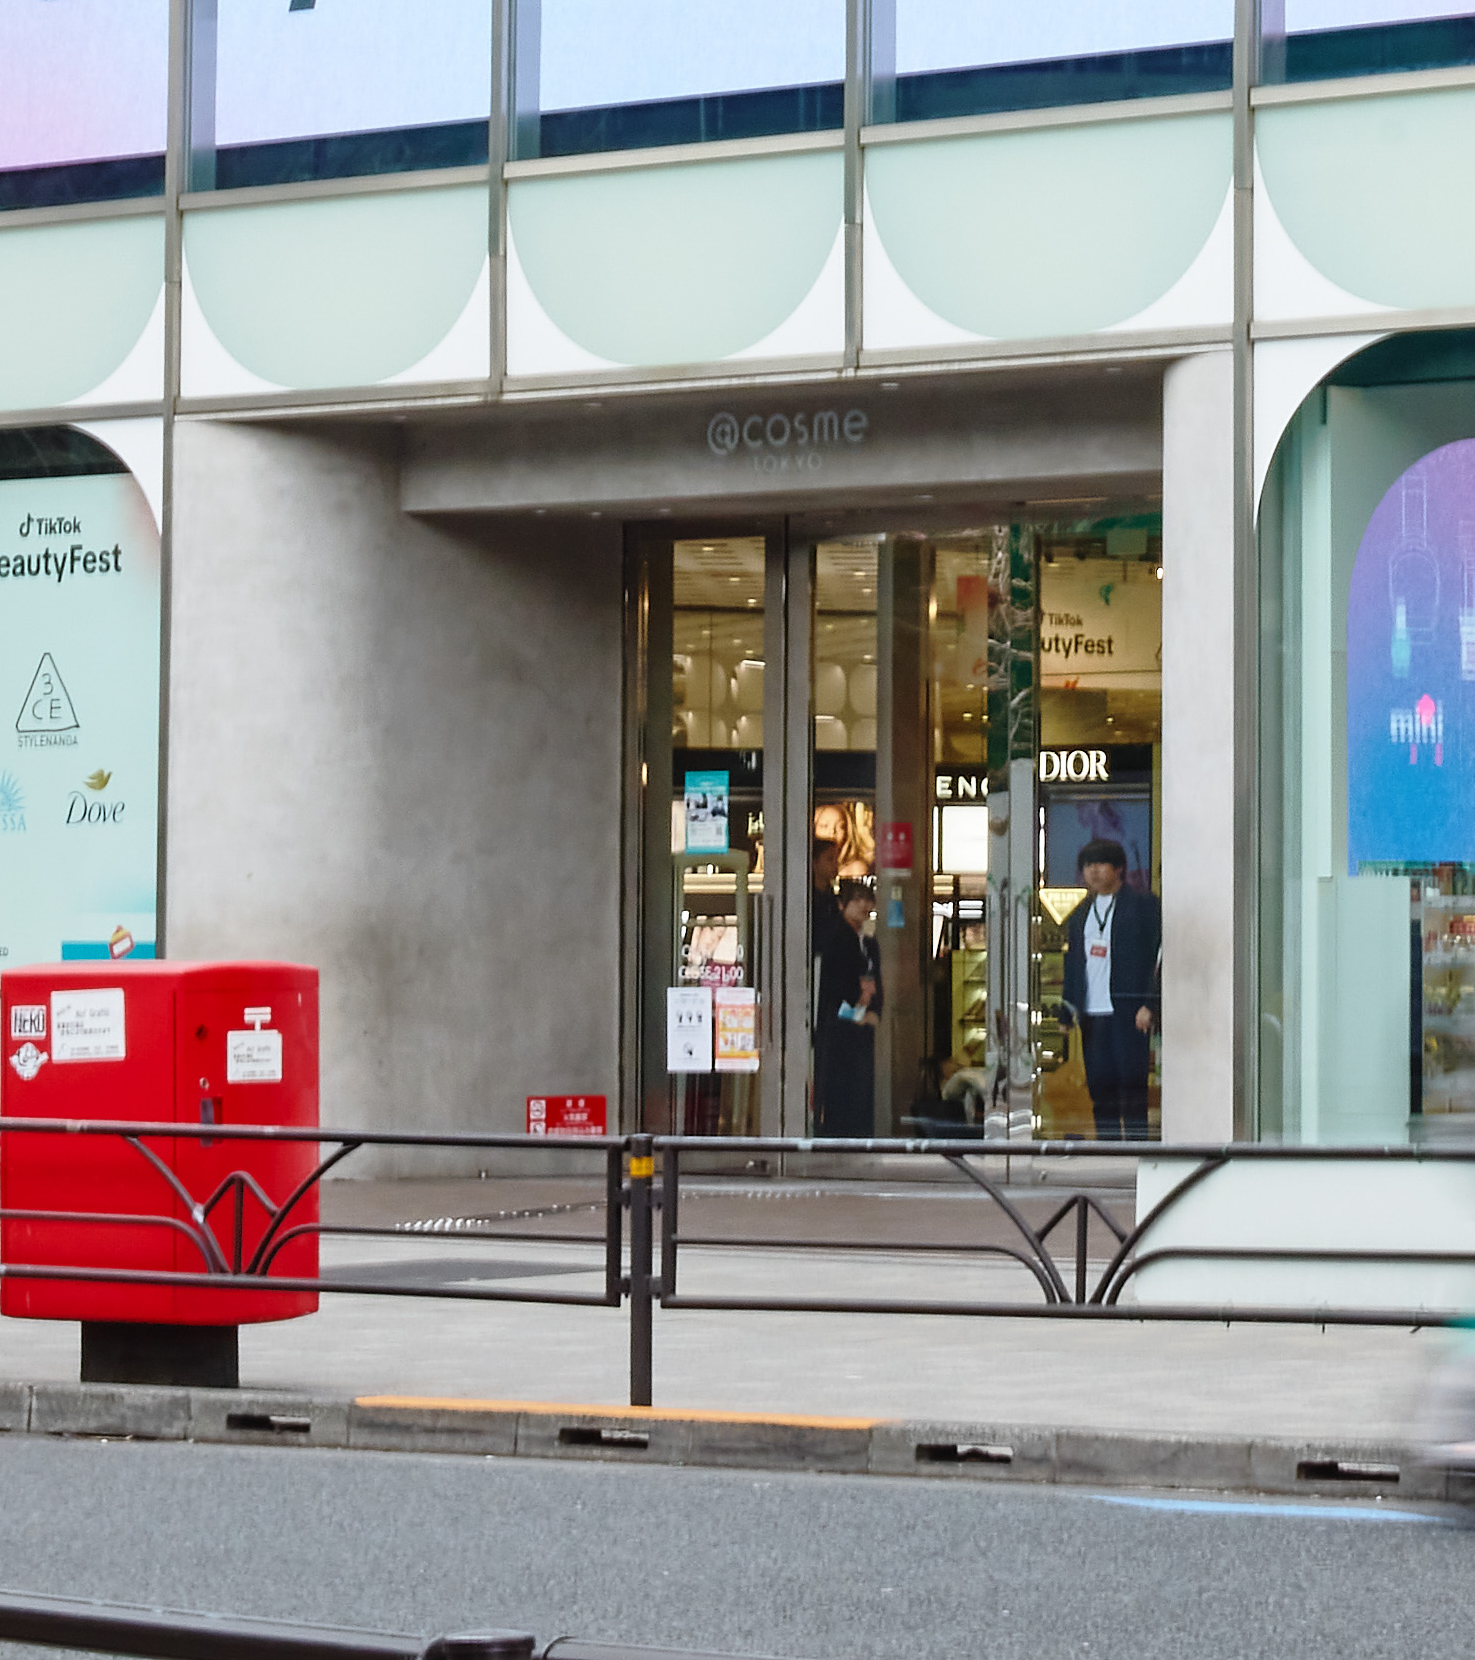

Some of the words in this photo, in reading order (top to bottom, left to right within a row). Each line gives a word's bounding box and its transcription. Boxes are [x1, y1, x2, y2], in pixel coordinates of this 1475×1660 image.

[707, 409, 869, 455] @cosme
[37, 517, 81, 536] TikTok
[1048, 613, 1084, 626] TikTok
[17, 735, 79, 748] STYLENANDA
[1039, 749, 1110, 782] DIOR
[66, 790, 125, 824] Dove
